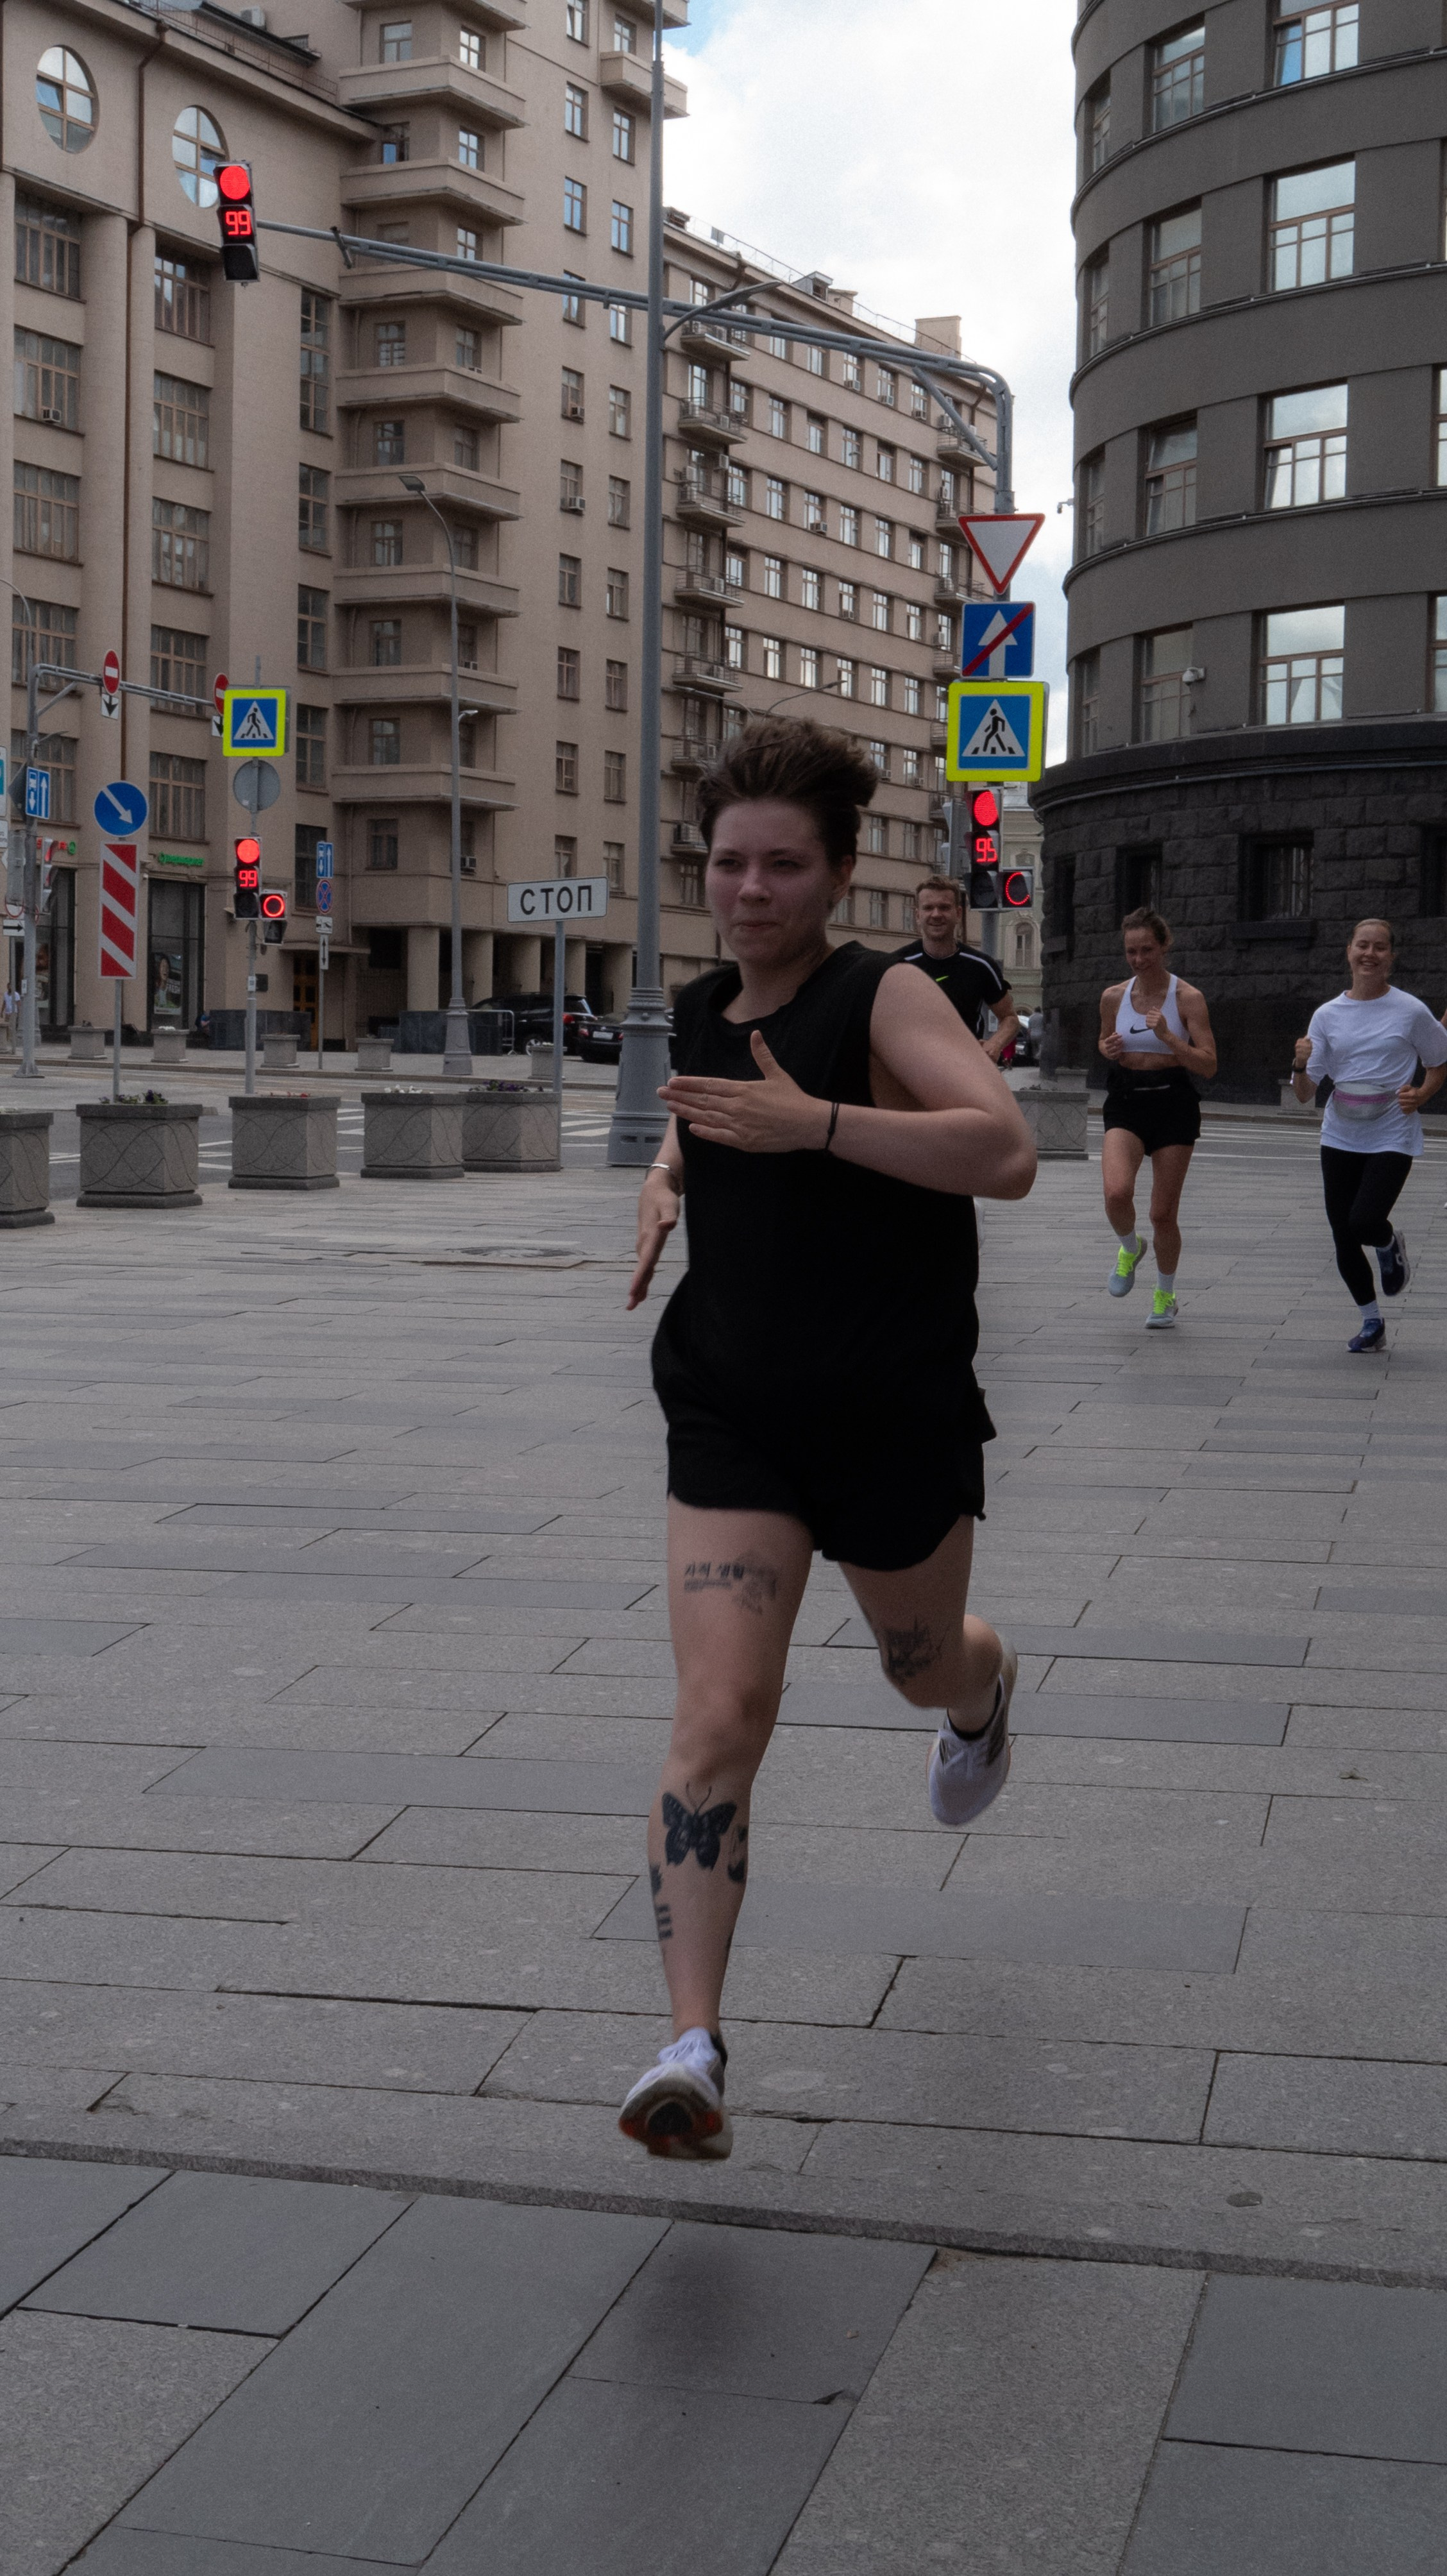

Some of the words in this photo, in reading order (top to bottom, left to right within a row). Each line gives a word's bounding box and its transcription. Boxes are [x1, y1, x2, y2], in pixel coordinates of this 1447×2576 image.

[226, 211, 251, 235] 99
[239, 870, 258, 887] 99
[520, 885, 591, 915] СТОП
